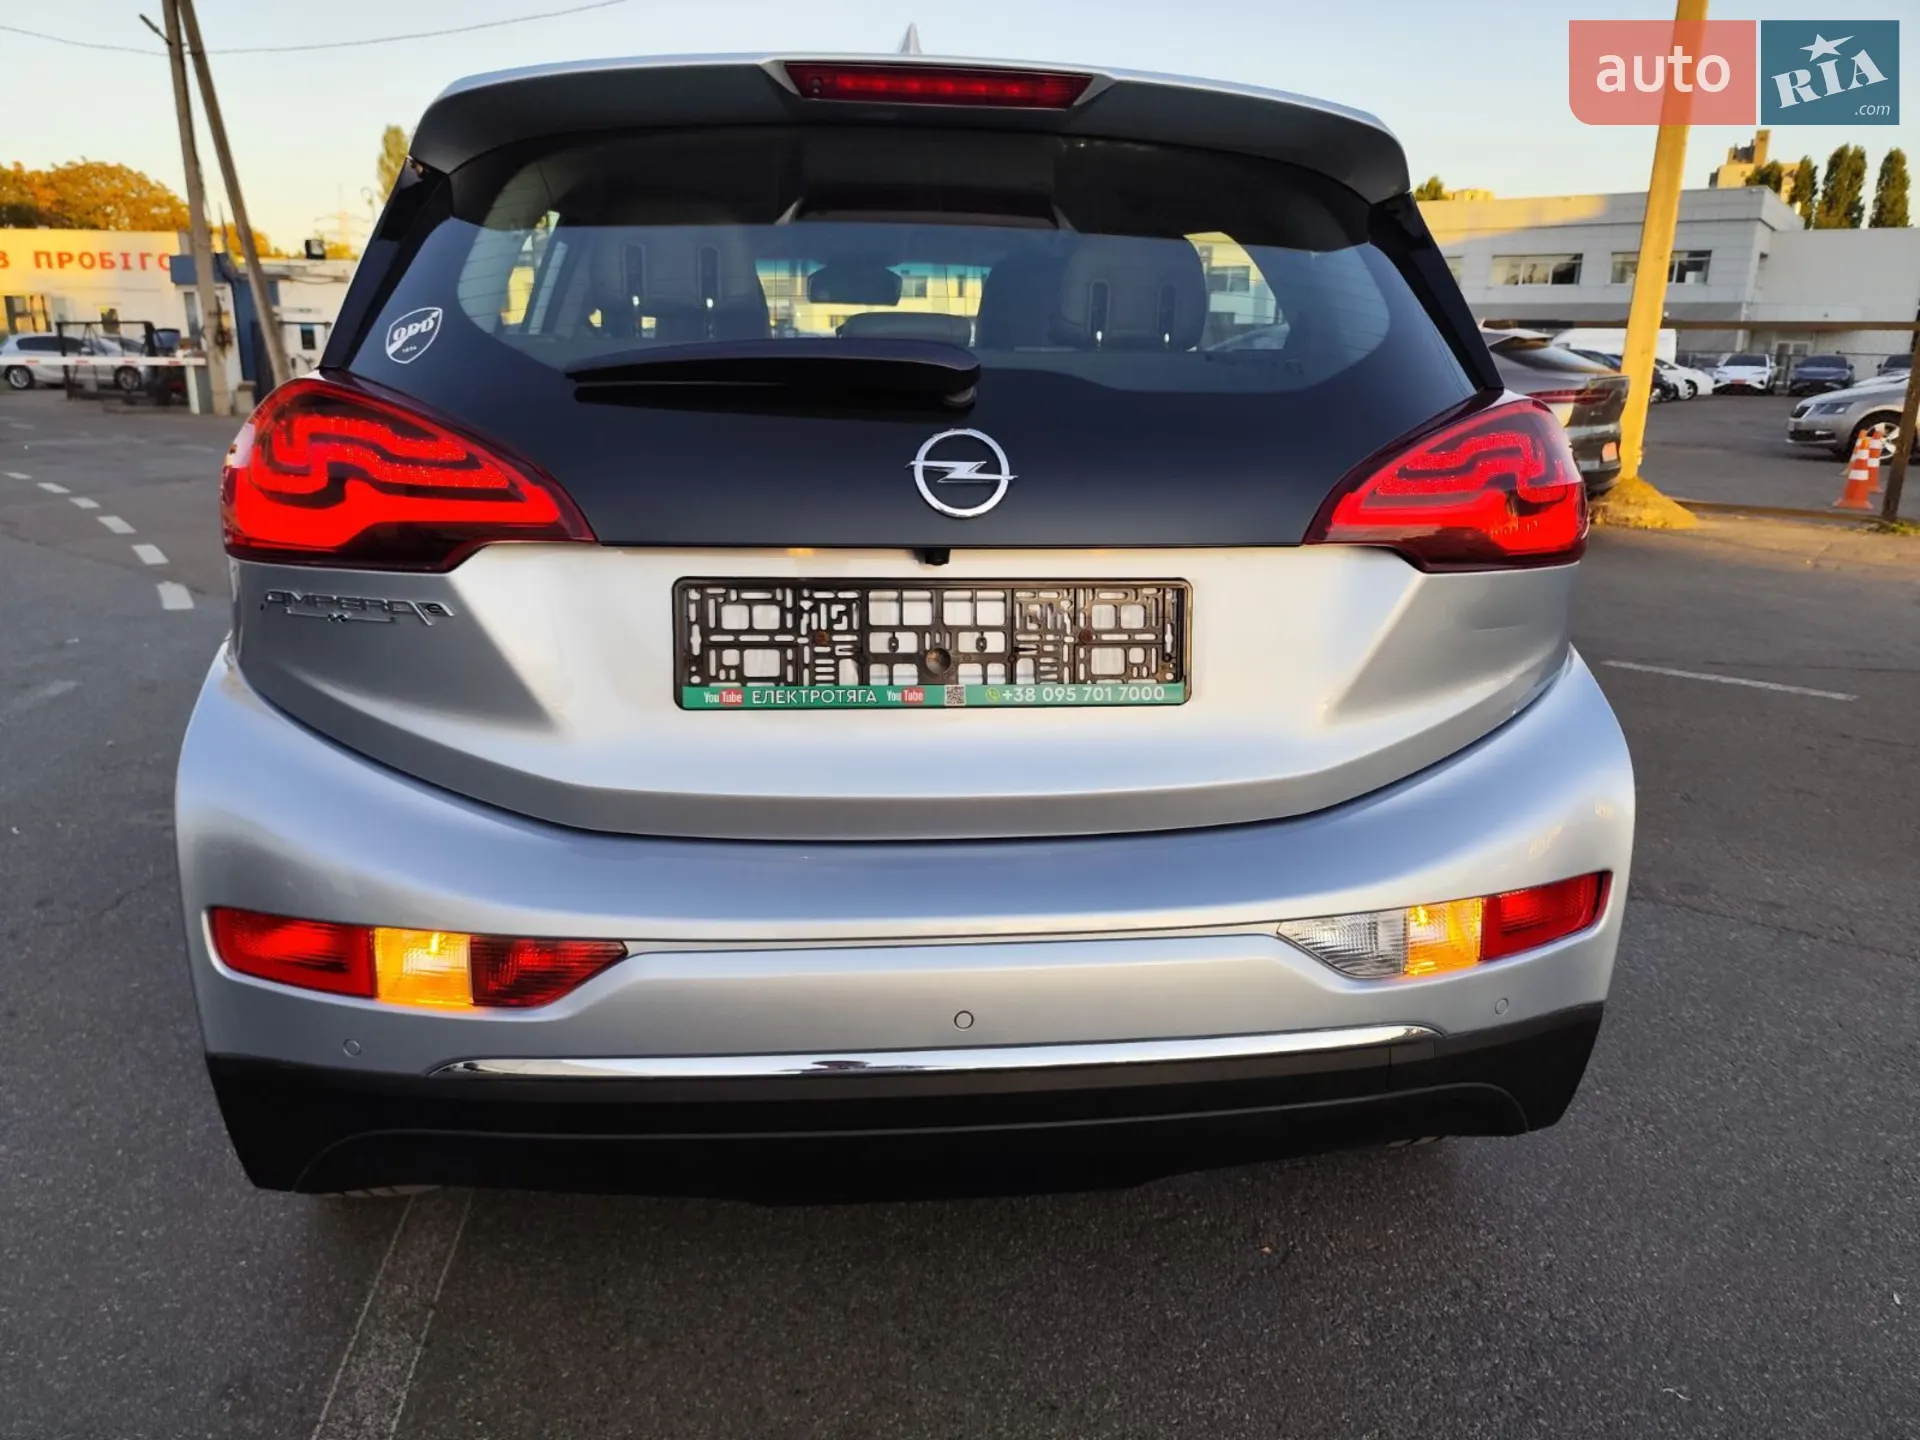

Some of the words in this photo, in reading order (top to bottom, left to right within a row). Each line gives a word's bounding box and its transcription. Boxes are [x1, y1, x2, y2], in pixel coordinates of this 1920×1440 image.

[752, 690, 877, 704] ЕЛЕКТРОТЯГА
[1002, 686, 1036, 702] +38
[1042, 686, 1076, 702] 095
[1083, 686, 1112, 701] 701
[1119, 686, 1165, 701] 7000
